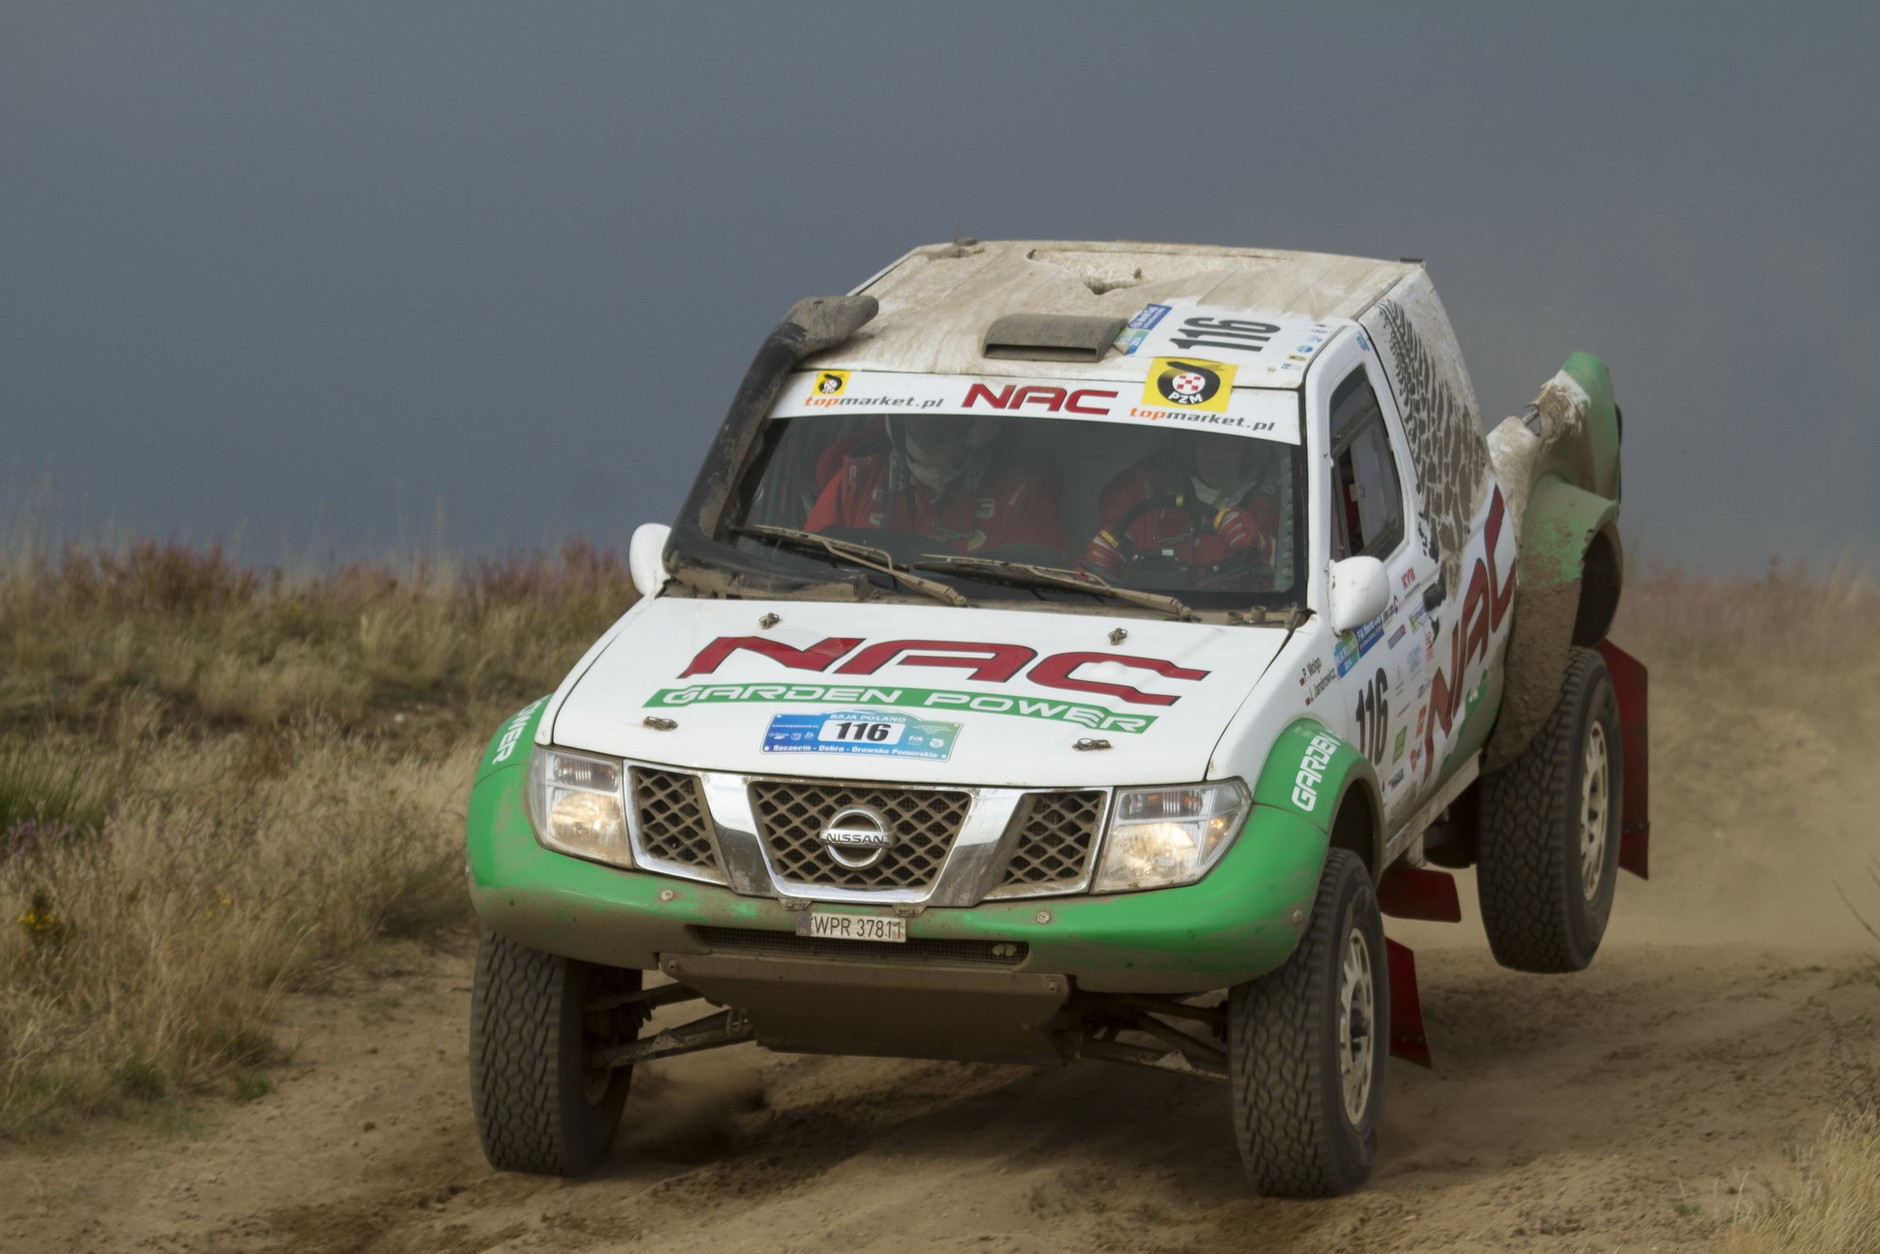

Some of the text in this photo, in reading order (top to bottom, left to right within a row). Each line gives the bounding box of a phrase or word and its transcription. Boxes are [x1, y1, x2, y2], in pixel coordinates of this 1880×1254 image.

[1169, 317, 1281, 352] 116
[805, 394, 944, 411] topmarket.pl
[960, 383, 1119, 416] NAC
[1168, 391, 1203, 404] PZM
[1129, 406, 1275, 432] topmarket.pl
[677, 636, 1212, 706] NAC
[663, 685, 1148, 734] GARDEN POWER
[859, 715, 907, 723] POLAND
[1355, 667, 1388, 766] 116
[836, 722, 891, 741] 116
[852, 746, 890, 755] Drawsko
[891, 749, 938, 759] Pomorskie
[826, 833, 885, 845] NISSAN
[814, 916, 902, 939] WPR 37811
